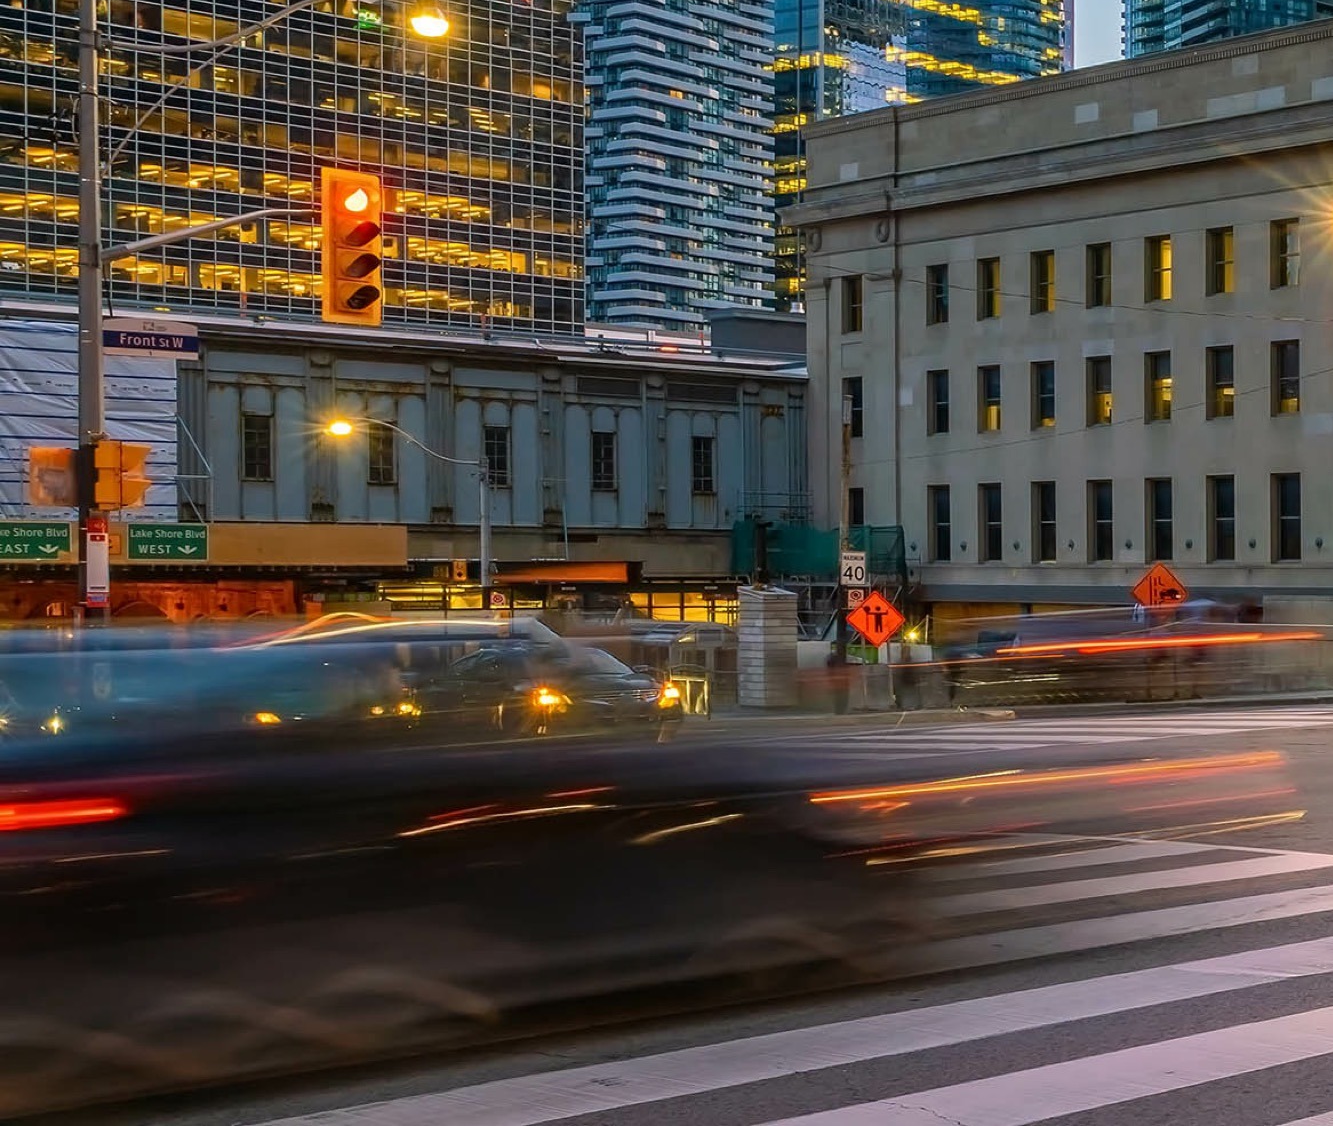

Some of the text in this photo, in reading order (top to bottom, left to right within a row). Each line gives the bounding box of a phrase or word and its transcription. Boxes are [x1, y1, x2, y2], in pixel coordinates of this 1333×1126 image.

[120, 333, 183, 348] Front St W
[13, 528, 43, 537] Shore
[46, 528, 68, 537] Blvd
[130, 529, 206, 539] Lake Shore Blvd
[138, 544, 171, 554] WEST
[843, 566, 864, 581] 40
